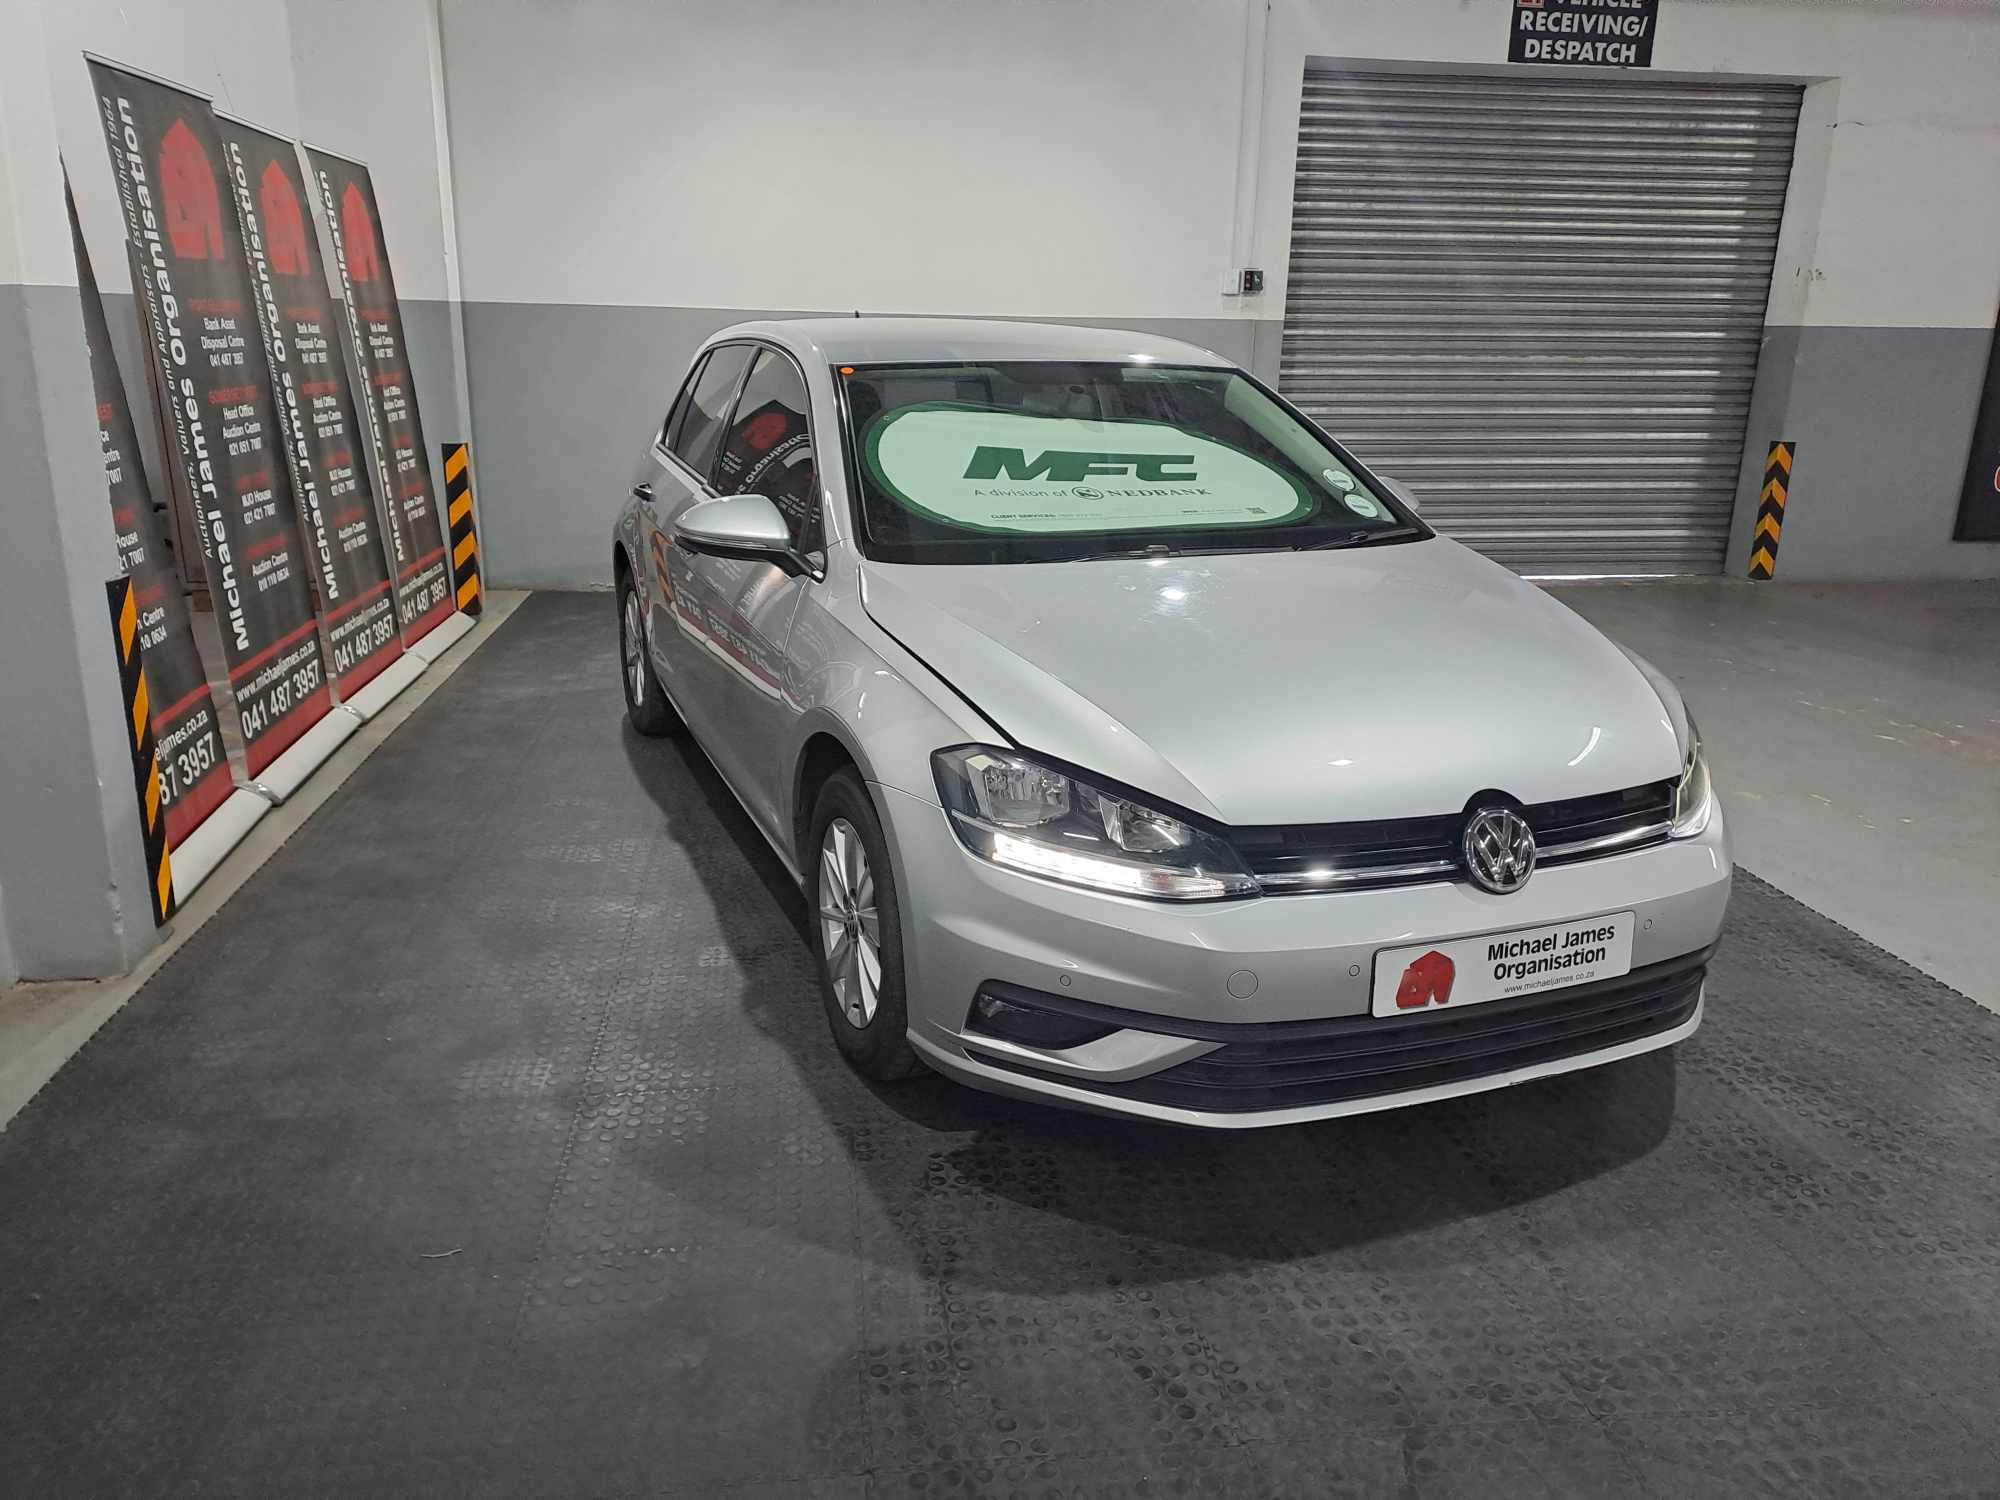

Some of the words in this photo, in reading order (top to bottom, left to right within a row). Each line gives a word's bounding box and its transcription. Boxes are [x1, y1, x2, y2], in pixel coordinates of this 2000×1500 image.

[1519, 10, 1649, 37] RECEIVING/
[1524, 38, 1637, 64] DESPATCH
[111, 144, 144, 249] Established
[117, 97, 187, 366] Organisation
[229, 142, 287, 362] Organisation
[181, 377, 218, 499] James
[281, 371, 312, 473] James
[962, 445, 1198, 482] MFC
[988, 487, 1050, 498] division
[1052, 488, 1068, 497] of
[1106, 487, 1213, 498] NEDBANK
[304, 481, 339, 600] Michael
[208, 509, 249, 651] Michael
[401, 600, 417, 624] 041
[416, 588, 429, 614] 487
[430, 576, 447, 604] 3957
[236, 640, 316, 703] www.michaeljames.co.za
[334, 640, 355, 673] 041
[355, 628, 373, 657] 487
[372, 614, 394, 646] 3957
[241, 698, 268, 739] 041
[270, 679, 291, 717] 487
[292, 658, 320, 699] 3957
[178, 730, 216, 785] 3957
[1487, 933, 1558, 961] Michael
[1561, 925, 1616, 949] James
[1493, 947, 1606, 980] Organisation
[1504, 970, 1595, 994] www.michaeljames.co.za
